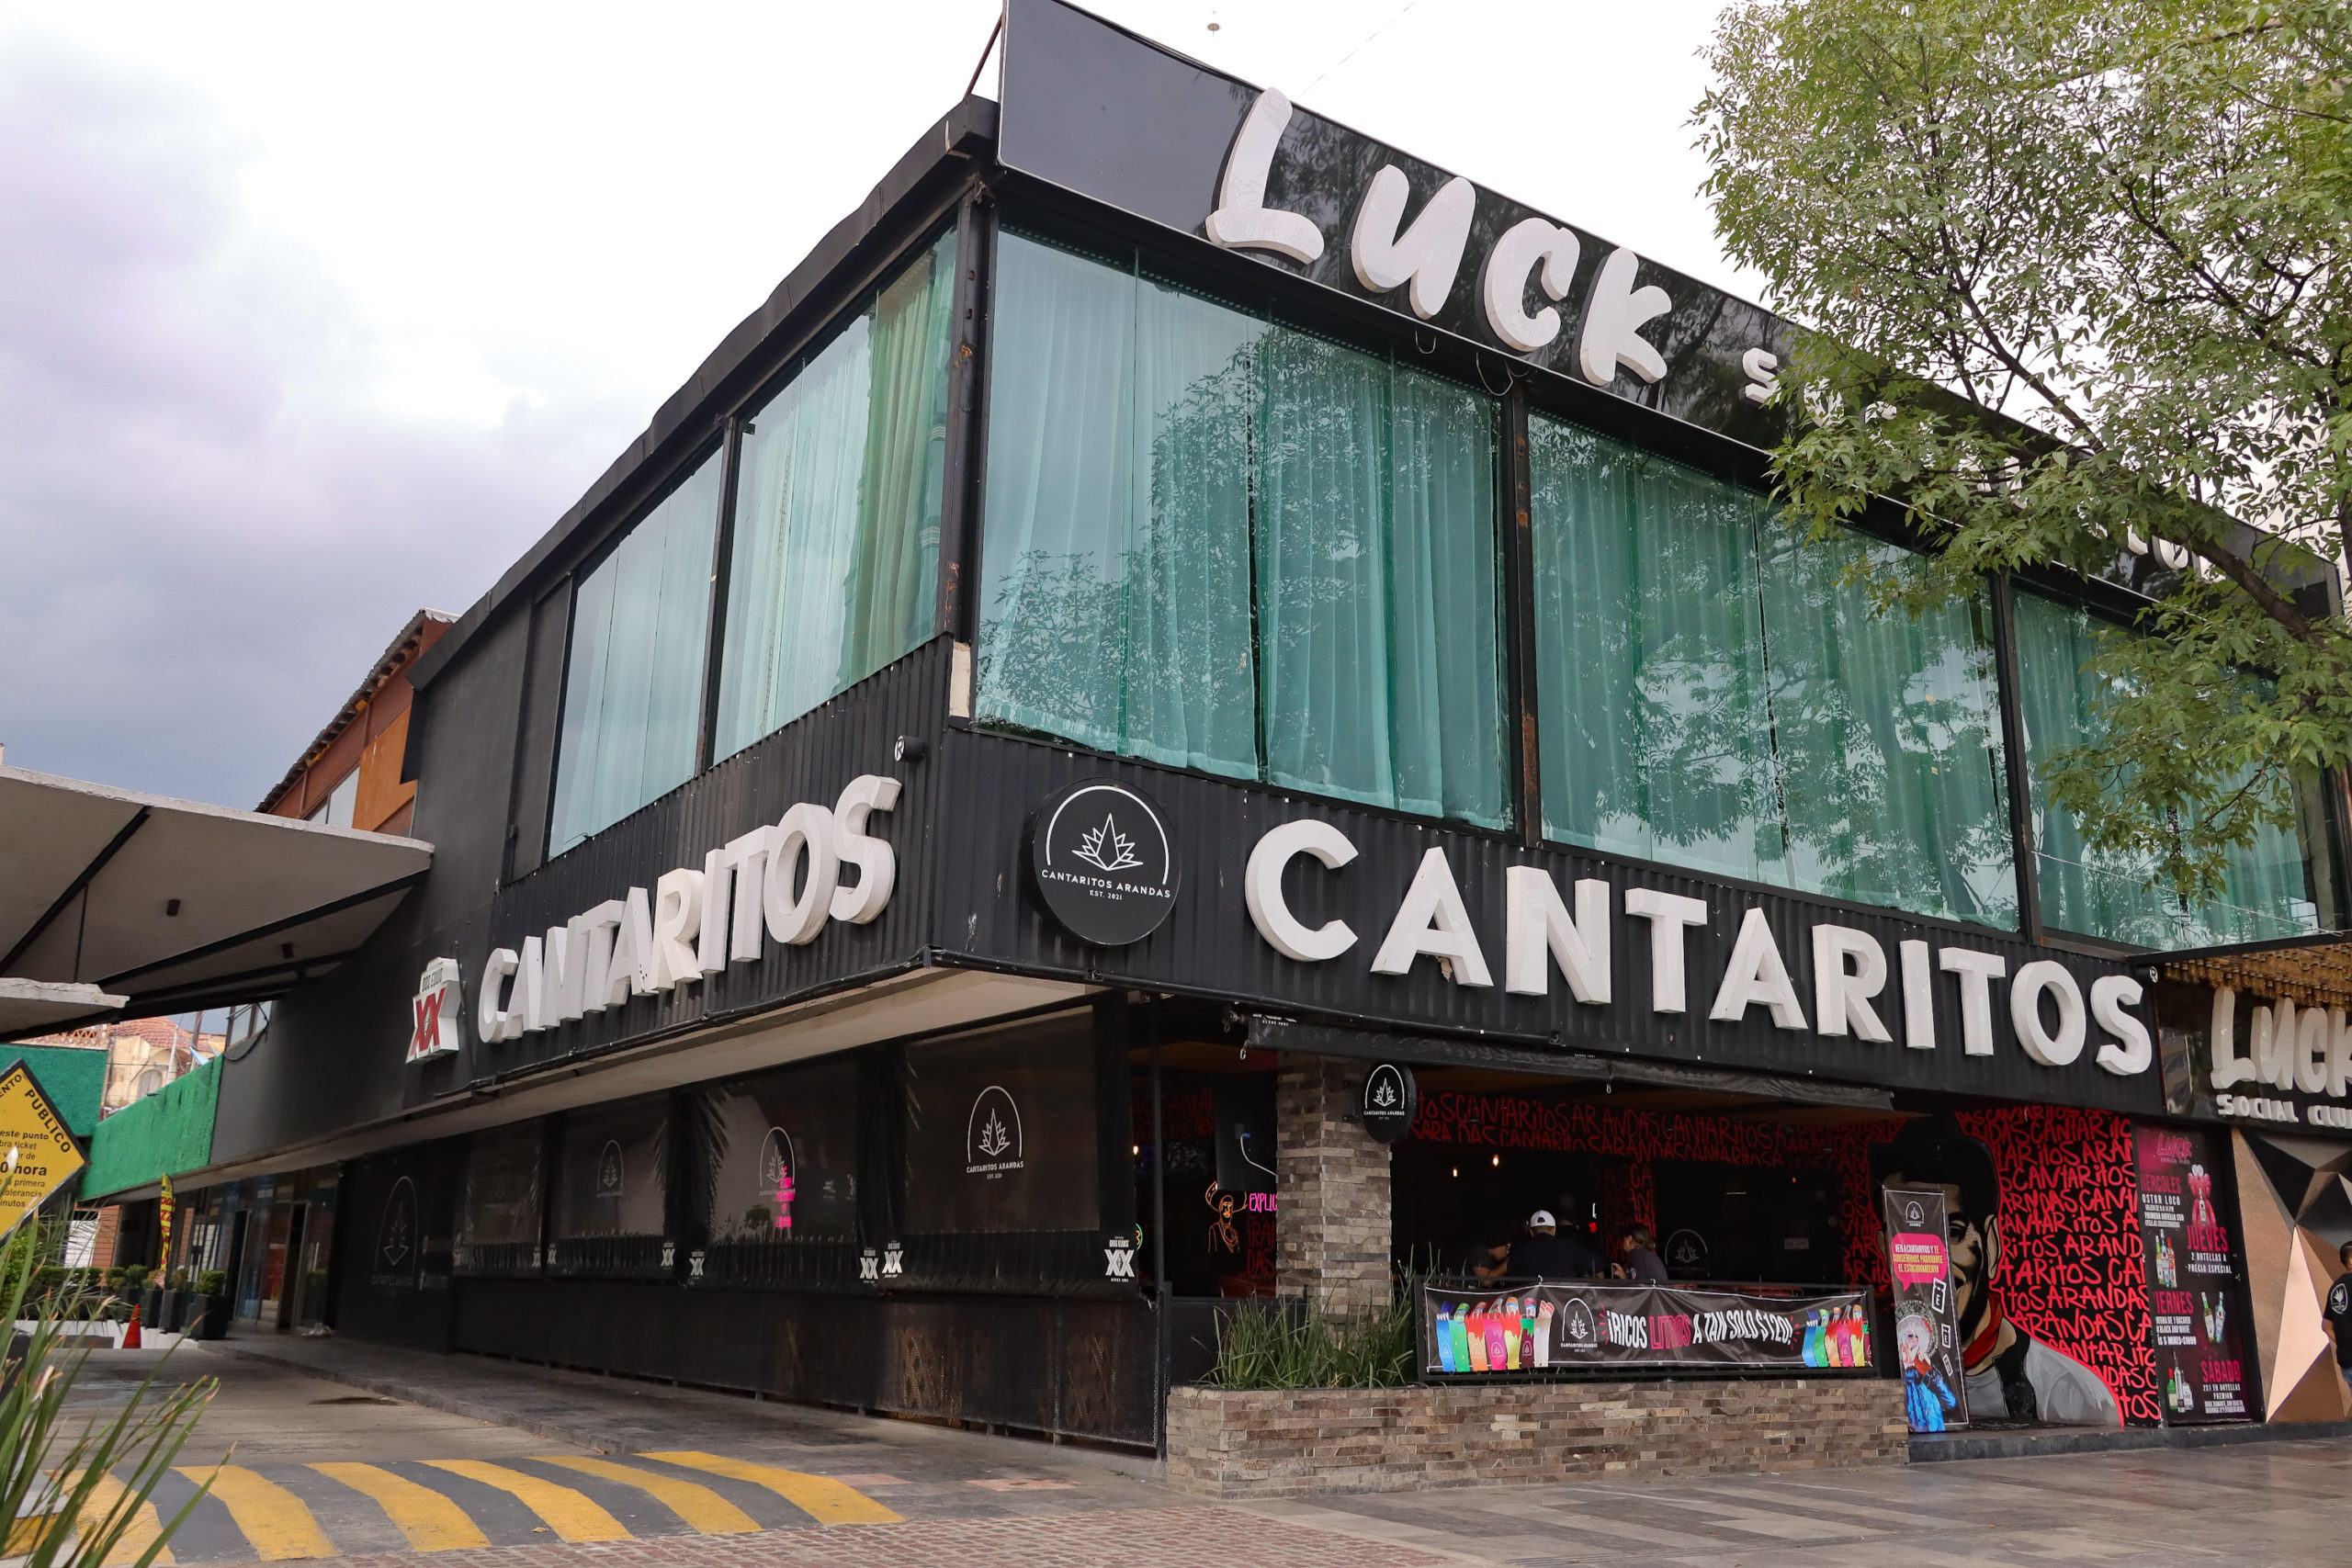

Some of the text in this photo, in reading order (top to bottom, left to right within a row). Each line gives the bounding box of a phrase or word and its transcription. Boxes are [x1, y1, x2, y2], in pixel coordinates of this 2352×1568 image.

[1205, 87, 1672, 386] LUCK
[1041, 869, 1171, 898] CANTARITOS ARANDAS
[1090, 889, 1123, 901] EST. 2021
[478, 774, 902, 1044] CANTARITOS
[1244, 818, 2153, 1076] CANTARITOS
[25, 1089, 71, 1153] PUBLICO
[2216, 1094, 2299, 1122] SOCIAL
[15, 1141, 37, 1150] ticket
[2156, 1132, 2192, 1157] LUCK
[967, 1160, 1024, 1173] CANTARITOS ARANDAS
[3, 1189, 42, 1198] olerancia
[14, 1179, 46, 1188] primera
[2165, 1194, 2181, 1206] LOCO
[2187, 1225, 2229, 1252] JUEVES
[1104, 1249, 1135, 1277] XX
[2188, 1263, 2233, 1274] PRECIO ESPECIAL
[2197, 1253, 2221, 1261] BOTELLAS
[1649, 1314, 1691, 1349] LITROS
[1692, 1314, 1702, 1344] A
[1703, 1312, 1728, 1343] TAN
[1725, 1310, 1759, 1340] SOLO
[2201, 1356, 2242, 1383] SÁBADO
